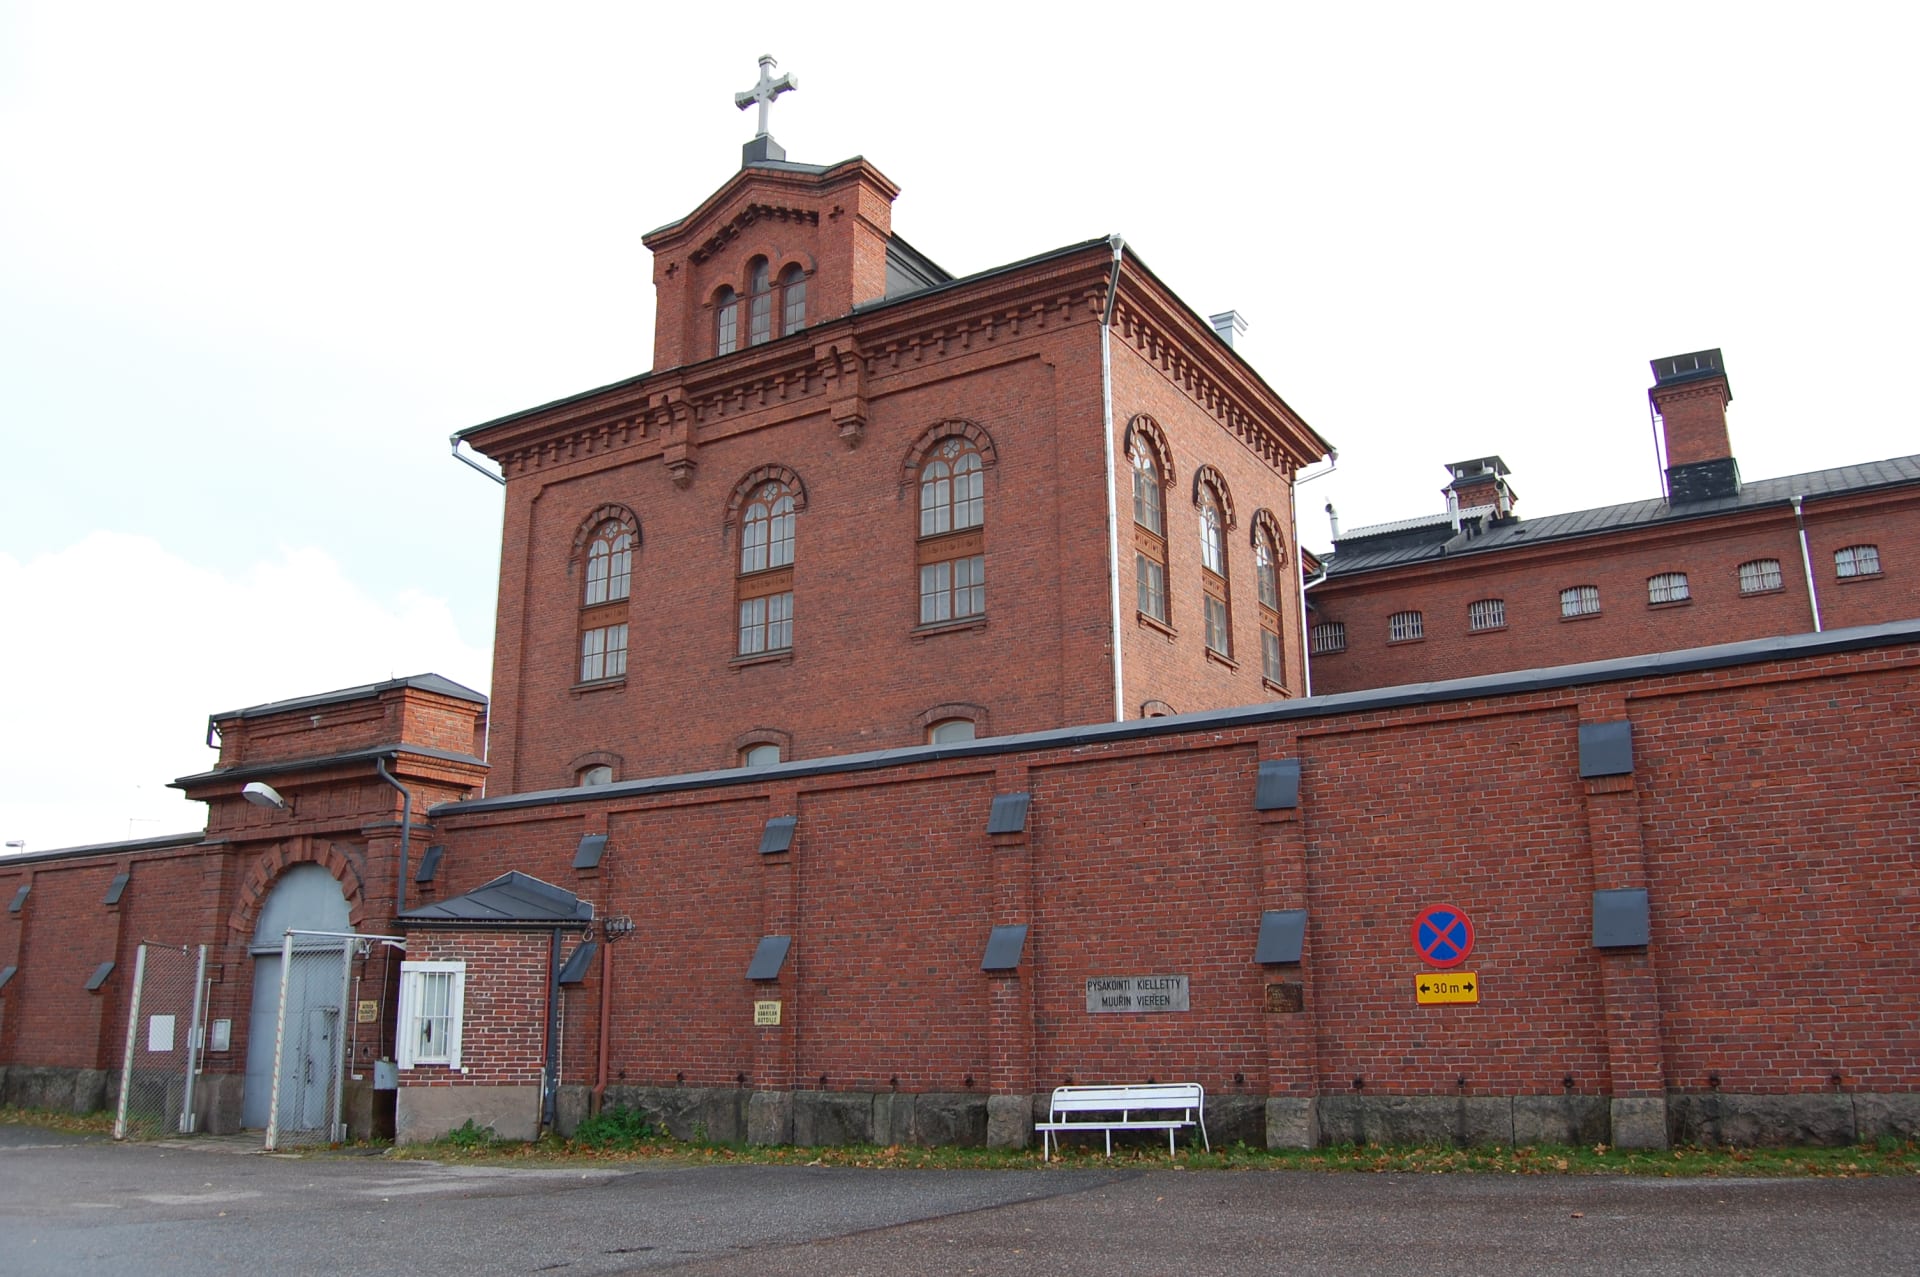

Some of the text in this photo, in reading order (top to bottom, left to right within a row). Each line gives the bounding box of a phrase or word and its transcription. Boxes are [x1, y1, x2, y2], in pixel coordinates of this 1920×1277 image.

[1136, 979, 1181, 990] KIELLETTY
[1433, 982, 1460, 994] 30 m
[1101, 995, 1170, 1007] MUURIN VIEREEN
